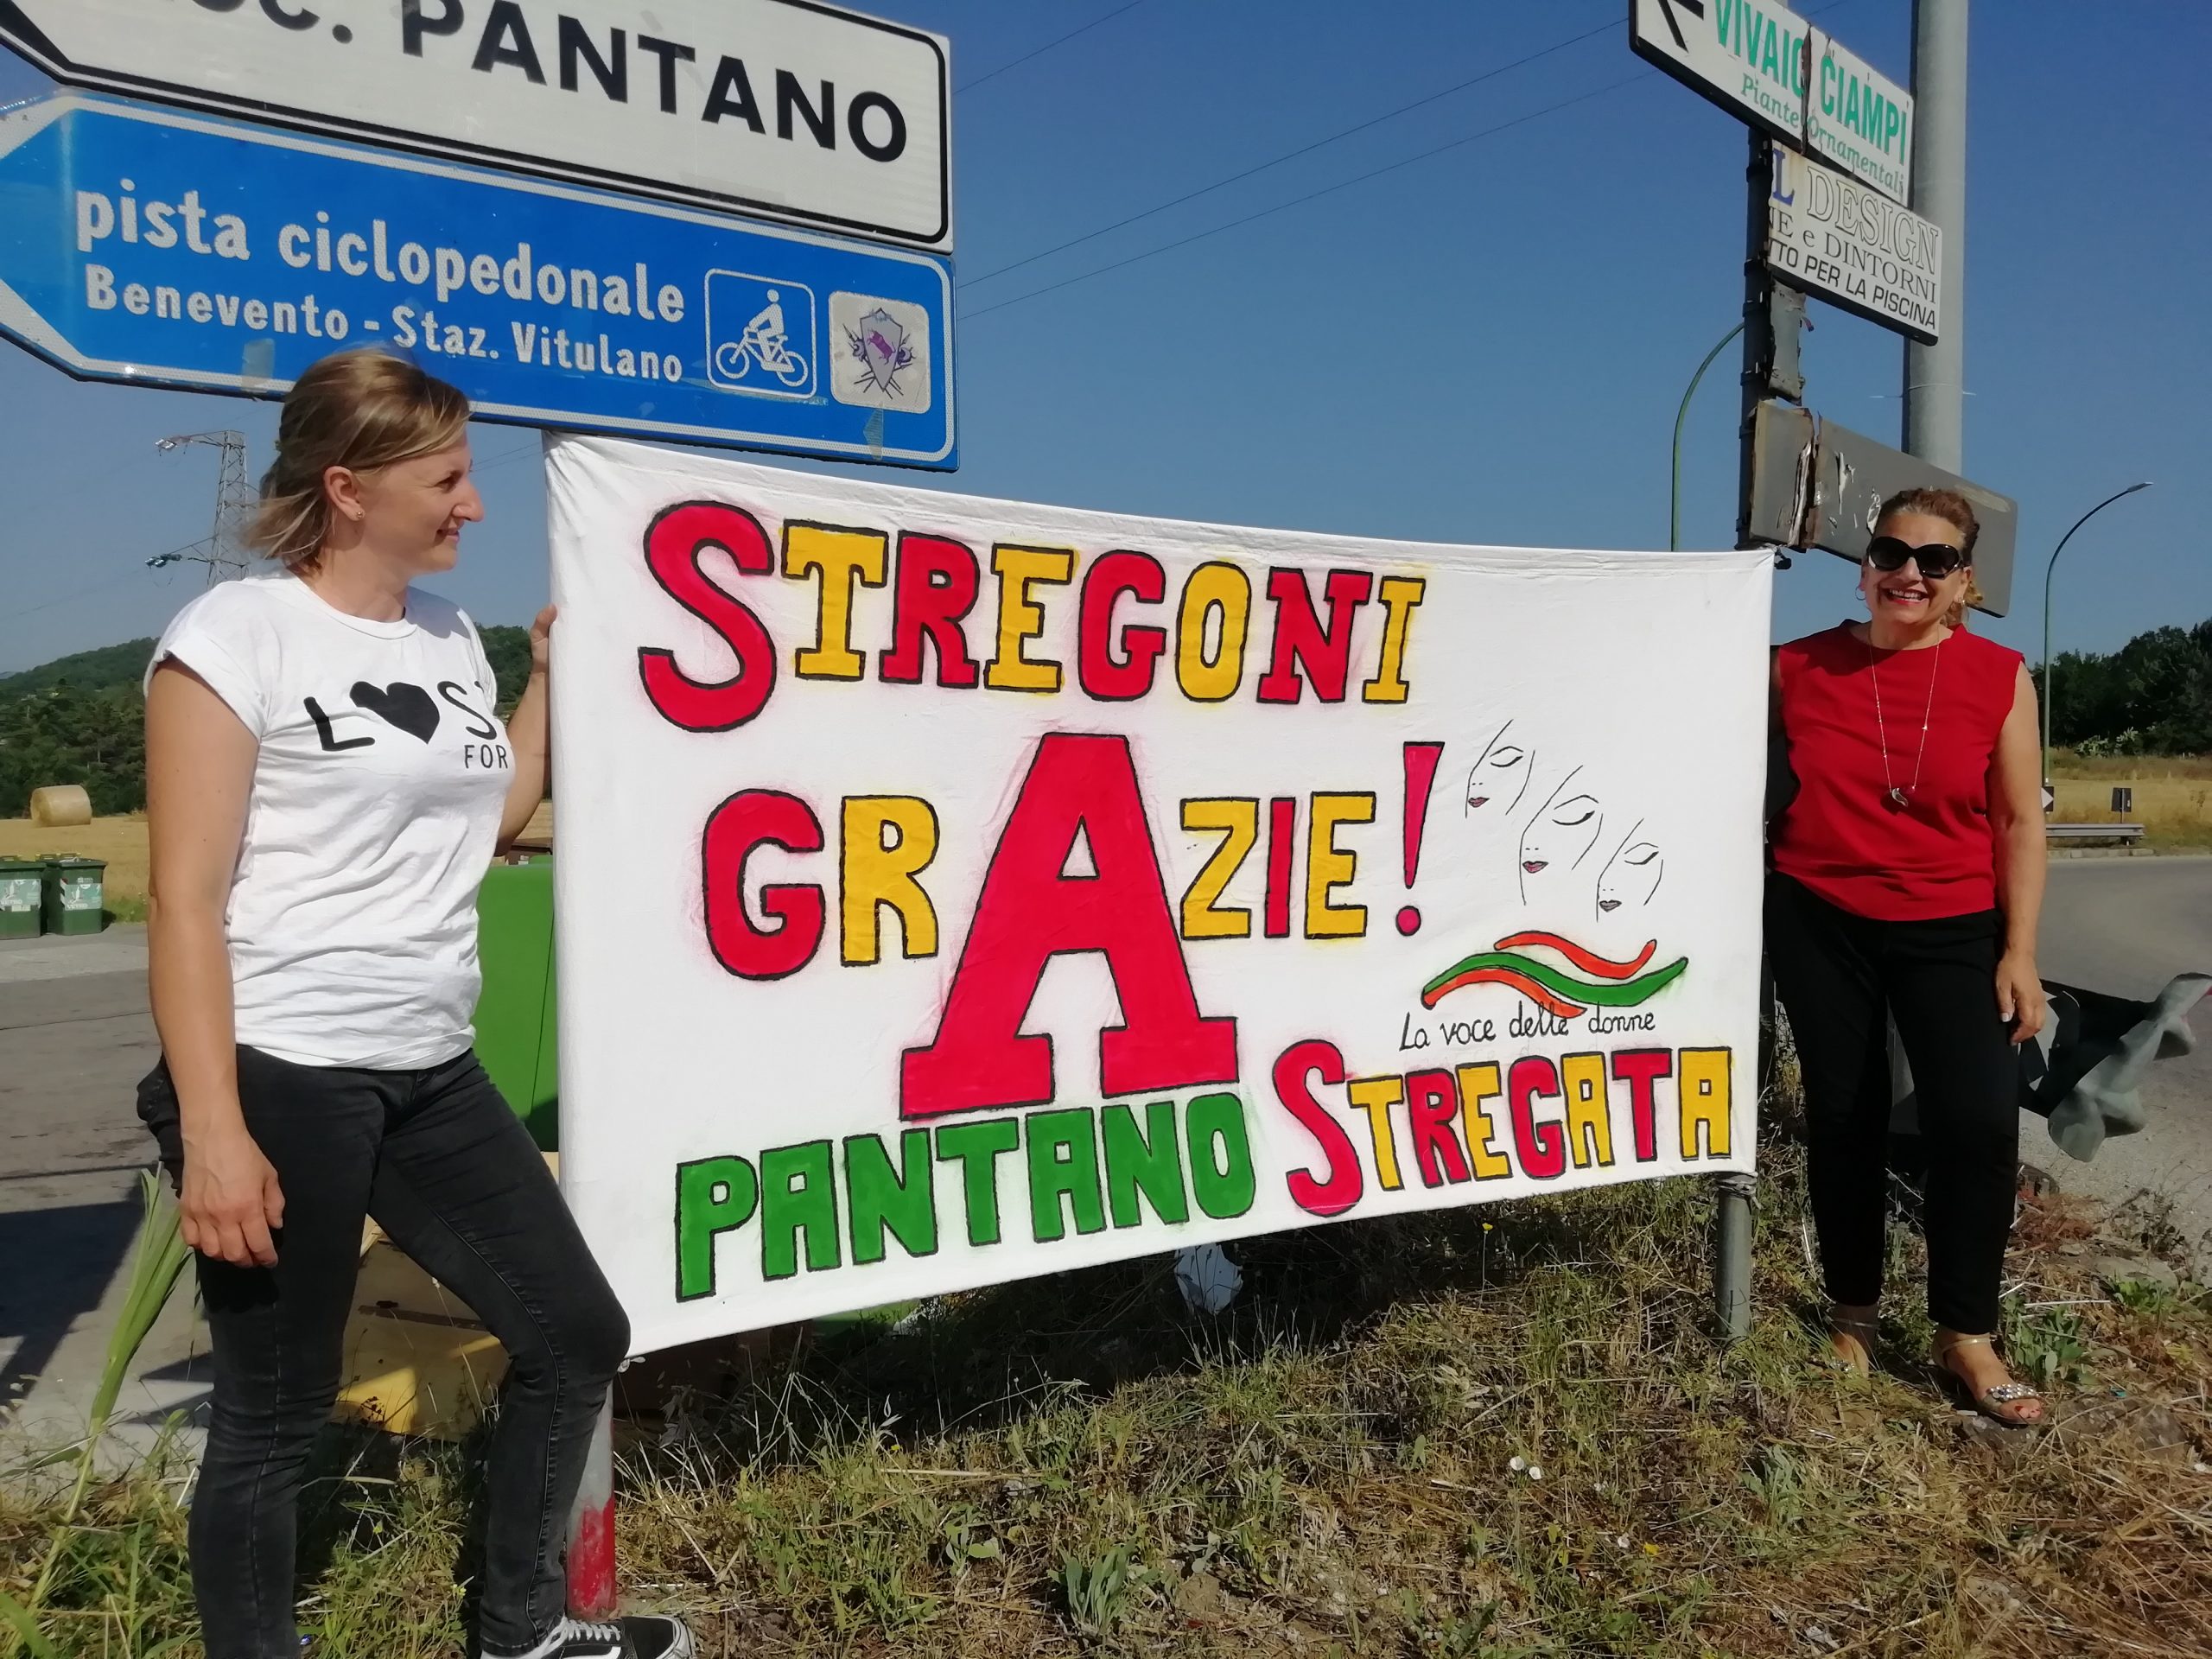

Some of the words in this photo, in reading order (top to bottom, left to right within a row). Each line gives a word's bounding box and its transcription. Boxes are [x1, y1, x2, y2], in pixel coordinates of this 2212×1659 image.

[401, 0, 907, 162] PANTANO
[1740, 73, 1799, 129] Piante
[1807, 114, 1904, 196] Ornamentali
[1820, 54, 1908, 167] CIAMPI
[76, 178, 251, 261] pista
[278, 211, 685, 323] ciclopedonale
[1802, 228, 1815, 248] e
[1824, 232, 1937, 304] DINTORNI
[1807, 165, 1939, 276] DESIGN
[86, 264, 349, 340] Benevento
[391, 305, 499, 359] Staz.
[511, 321, 683, 383] Vitulano
[1804, 254, 1841, 288] PER
[1845, 273, 1866, 299] LA
[1872, 285, 1936, 330] PISCINA
[638, 499, 1427, 734] STREGONI
[463, 744, 508, 769] FOR
[1398, 1012, 1431, 1052] La
[1439, 1018, 1497, 1047] voce
[1508, 1000, 1569, 1038] delle
[1588, 1000, 1656, 1034] donne
[676, 1091, 1256, 1303] PANTANO
[1272, 1039, 1732, 1217] STREGATA
